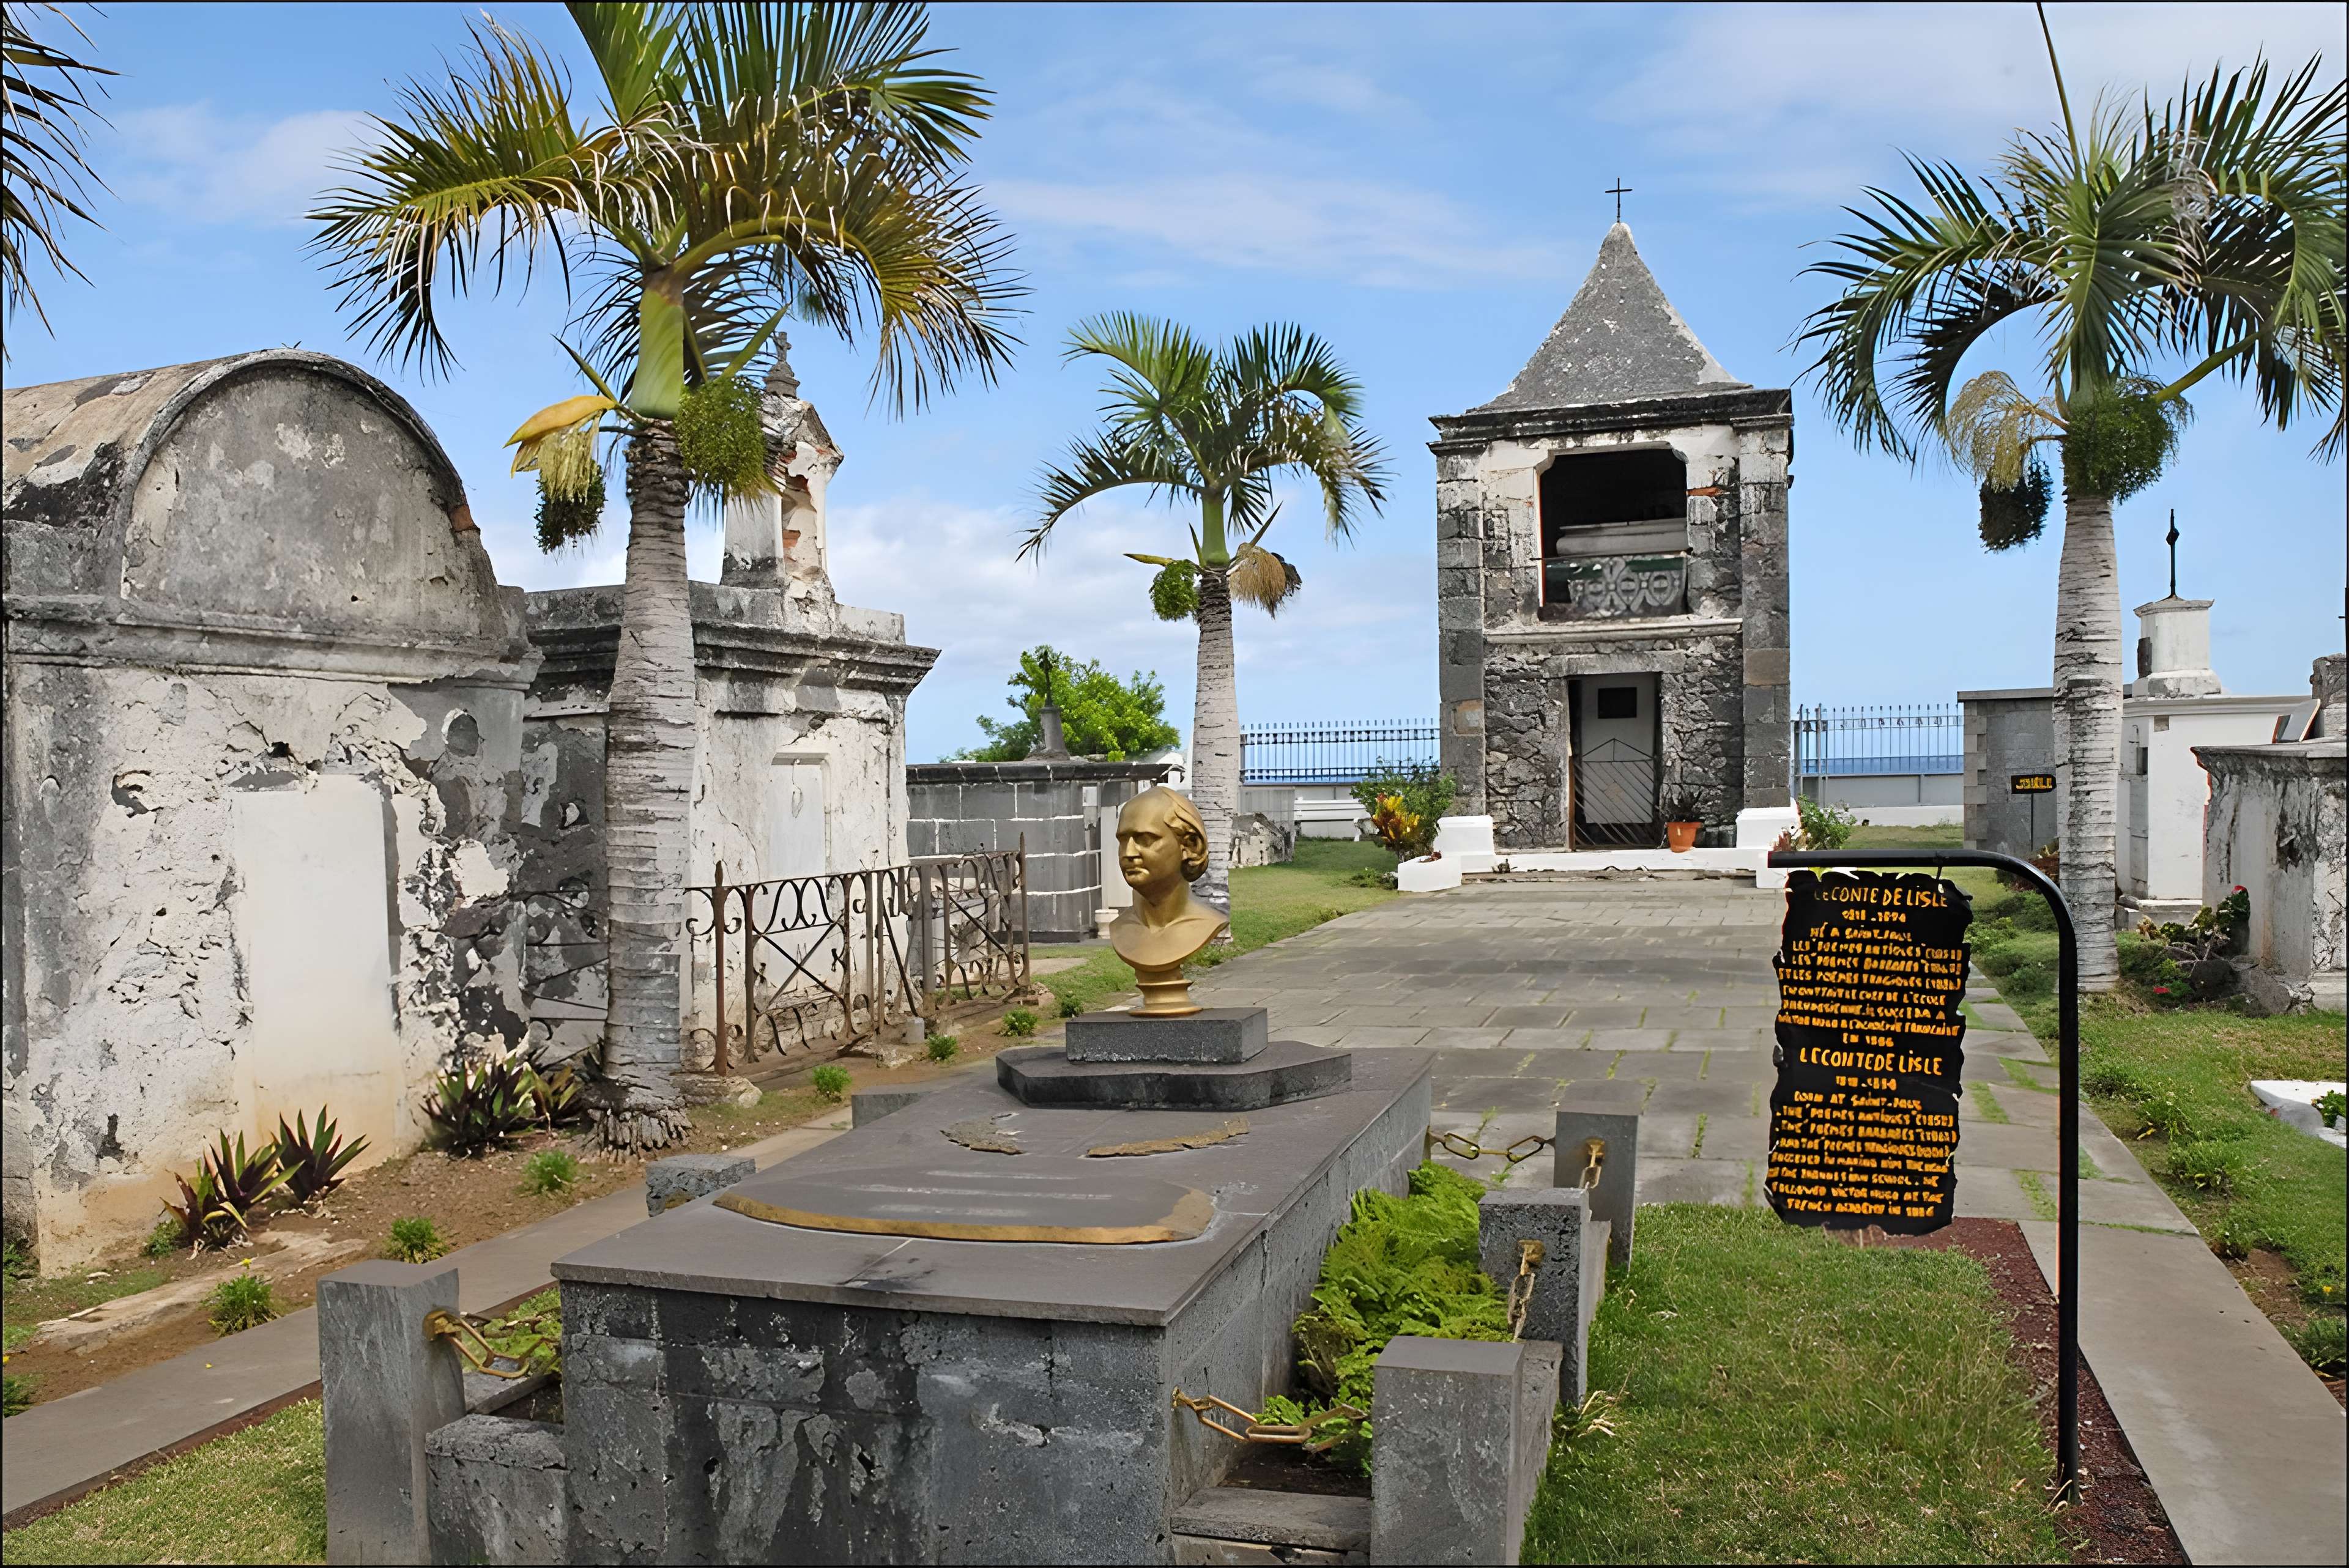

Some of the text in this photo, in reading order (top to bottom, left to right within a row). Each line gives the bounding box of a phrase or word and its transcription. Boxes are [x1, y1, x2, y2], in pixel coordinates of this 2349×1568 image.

[1882, 887, 1903, 906] DE
[1906, 886, 1947, 908] LISLE
[1898, 1049, 1943, 1076] LISLE
